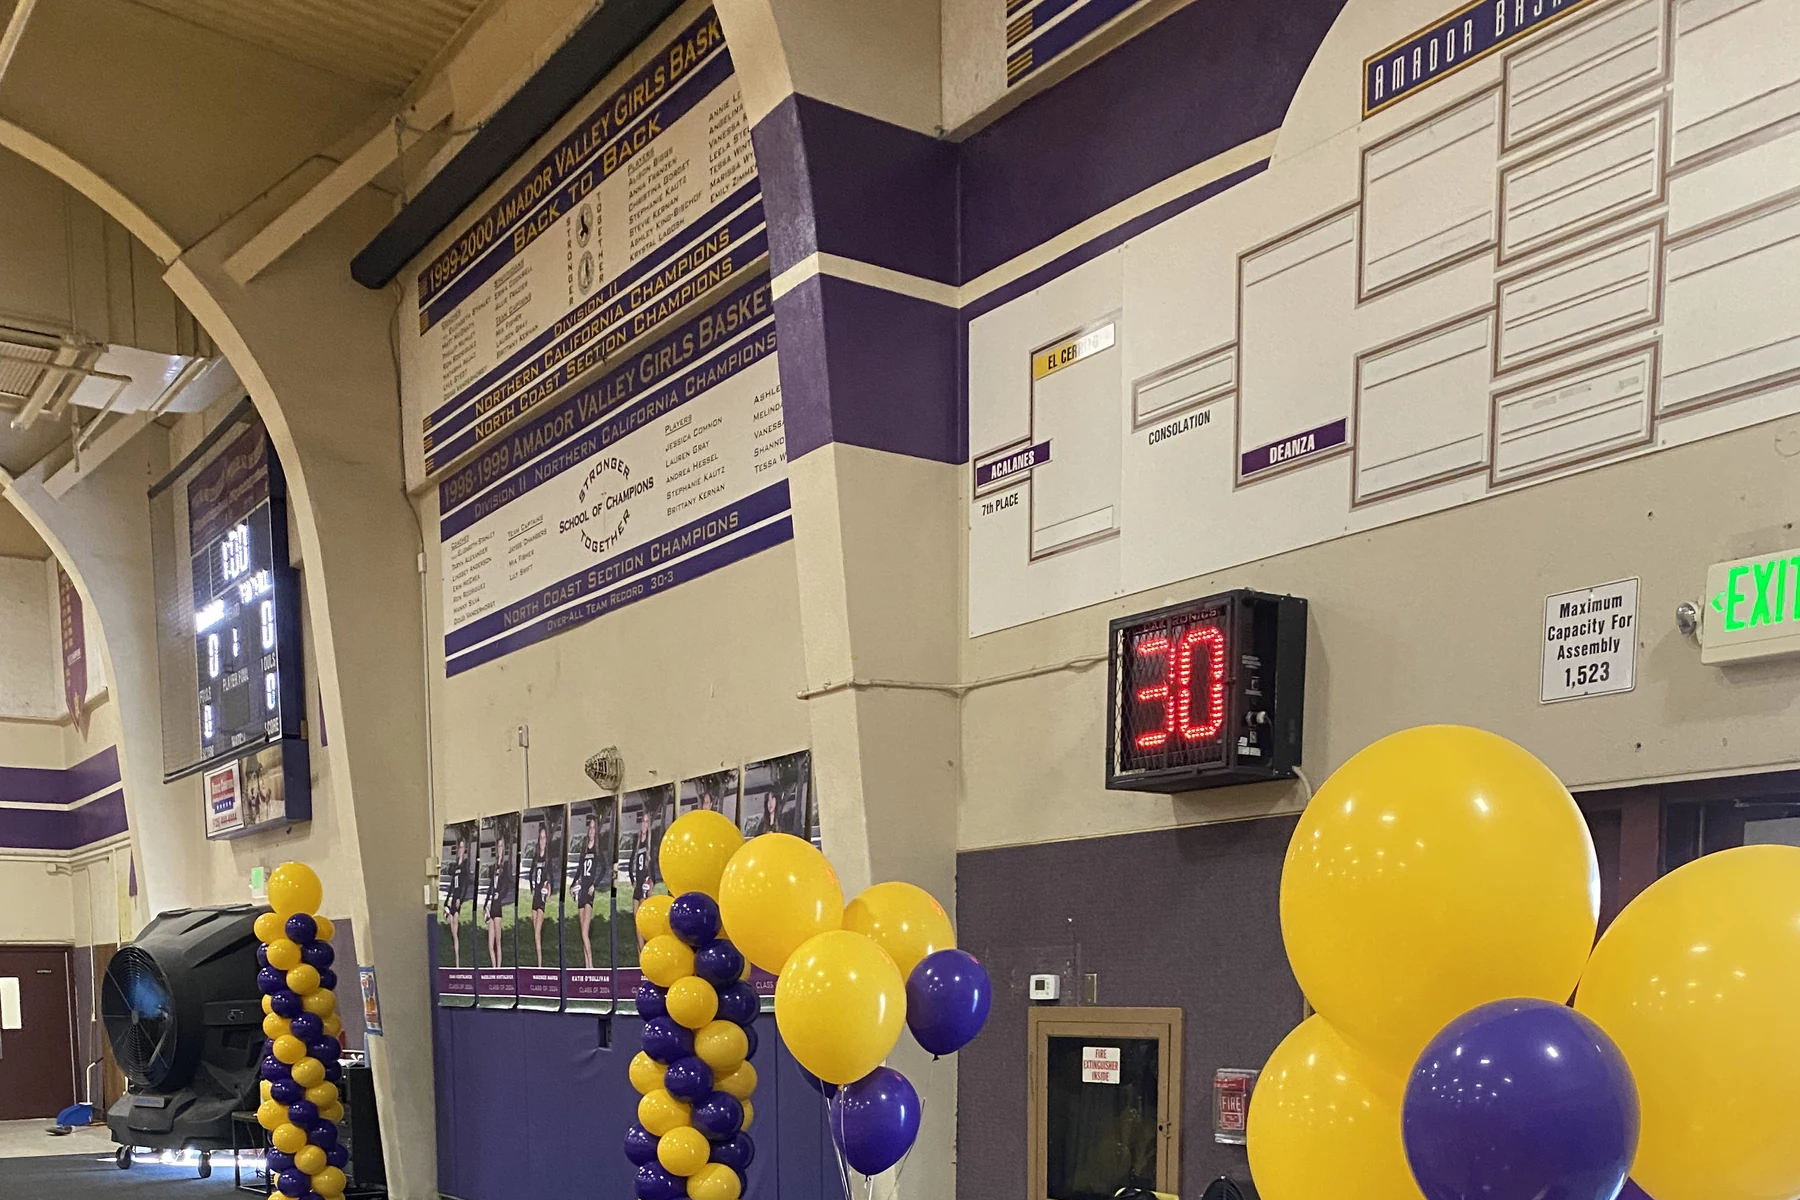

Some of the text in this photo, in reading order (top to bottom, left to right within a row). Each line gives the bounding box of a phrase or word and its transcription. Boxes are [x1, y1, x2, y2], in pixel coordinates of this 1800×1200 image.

[1374, 18, 1473, 101] AMADOR
[429, 216, 494, 292] 1999-2000
[496, 165, 552, 234] AMADOR
[554, 111, 611, 178] VALLEY
[614, 65, 665, 126] GIRLS
[513, 111, 662, 253] BACK TO BACK
[475, 362, 539, 417] NORTHERN
[543, 303, 624, 370] CALIFORNIA
[630, 227, 730, 310] CHAMPIONS
[554, 294, 604, 339] DIVISION
[475, 404, 515, 442] NORTH
[519, 372, 561, 411] COAST
[566, 327, 626, 380] SECTION
[634, 257, 733, 335] CHAMPIONS
[1047, 353, 1058, 370] EL
[444, 447, 509, 508] 1998-1999
[512, 410, 574, 465] AMADOR
[576, 367, 636, 423] VALLEY
[639, 333, 694, 384] GIRLS
[474, 485, 515, 518] DIVISION
[534, 438, 597, 484] NORTHERN
[601, 389, 678, 445] CALIFORNIA
[685, 330, 777, 397] CHAMPIONS
[664, 414, 692, 434] PLAYERS
[753, 402, 782, 422] MELIND
[1148, 409, 1211, 446] CONSOLATION
[665, 434, 692, 452] JESSICA
[665, 440, 711, 468] LAUREN GRAY
[1269, 433, 1315, 465] DEANZA
[665, 467, 691, 484] ANDREA
[754, 458, 777, 474] TESSA
[990, 450, 1035, 480] ACALANES
[579, 457, 630, 504] STRONGER
[666, 466, 725, 500] STEPHANIE KAUTZ
[559, 476, 654, 534] SCHOOL OF CHAMPIONS
[667, 483, 726, 517] BRITTANY KERNAN
[981, 492, 1019, 516] 7th PLACE
[580, 508, 631, 553] TOGETHER
[503, 511, 739, 628] NORTH COAST SECTION CHAMPIONS
[547, 570, 674, 631] OVER-ALL TEAM RECORD 30-3
[1559, 594, 1623, 619] Maximum
[1143, 608, 1217, 632] DAKRONICS
[1547, 613, 1633, 642] Capacity For
[1556, 635, 1621, 661] Assembly
[1136, 626, 1224, 749] 30
[1564, 661, 1611, 690] 1,523
[583, 859, 592, 877] 12
[755, 981, 774, 989] CLASS
[1083, 1060, 1119, 1071] EXTINGUISHER
[1095, 1048, 1107, 1059] FIRE
[1091, 1071, 1109, 1081] INSIDE
[1221, 1096, 1242, 1112] FIRE
